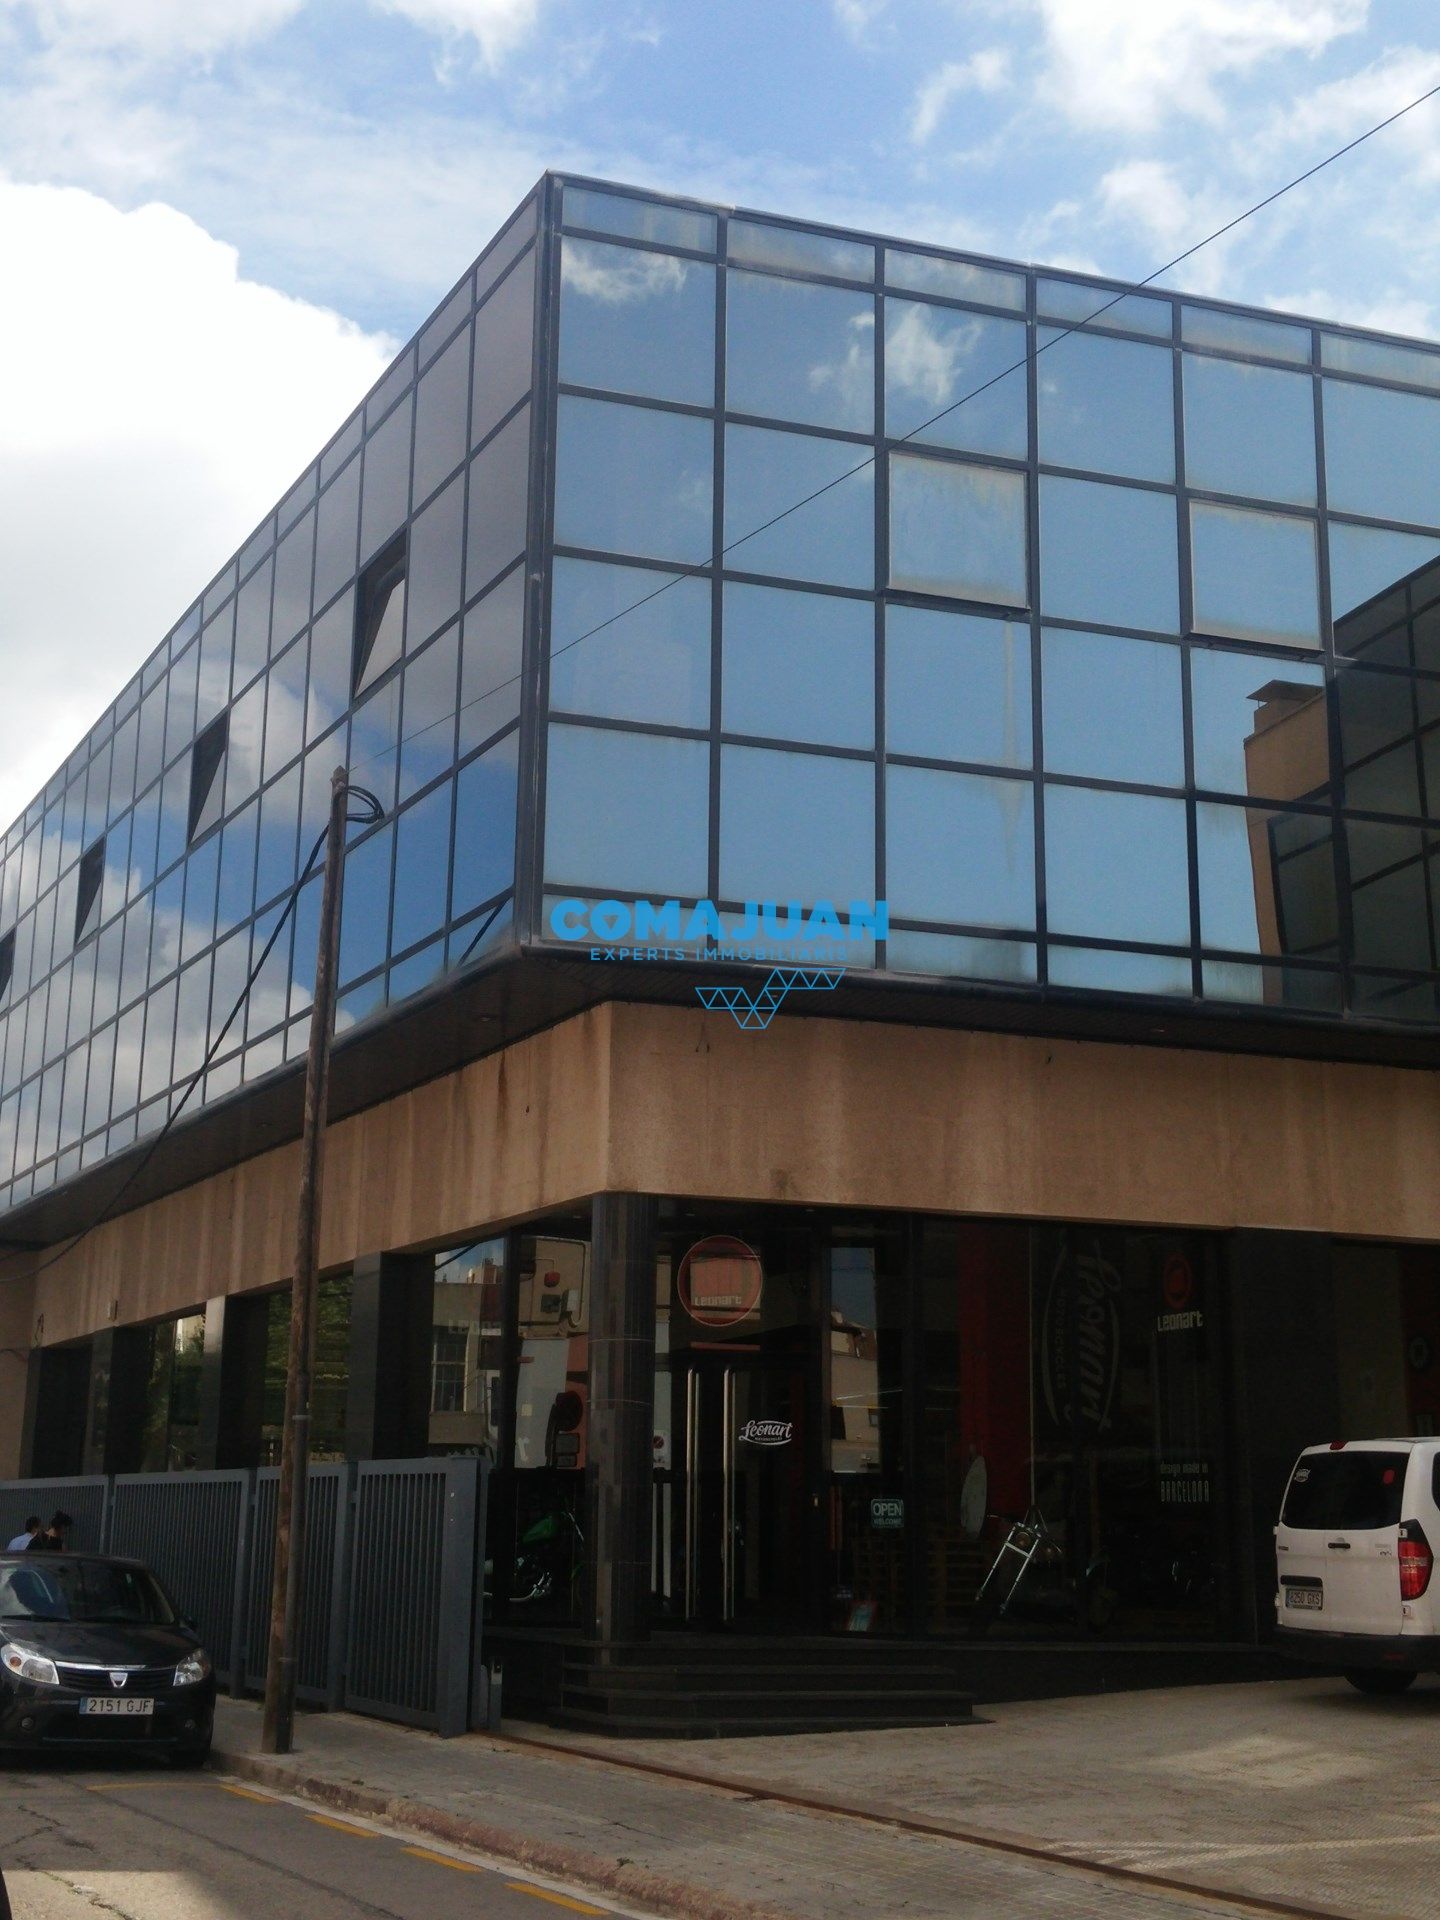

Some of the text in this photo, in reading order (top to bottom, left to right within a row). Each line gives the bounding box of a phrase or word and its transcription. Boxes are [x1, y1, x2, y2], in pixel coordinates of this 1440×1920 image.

[694, 1295, 742, 1307] Leonart
[1156, 1309, 1204, 1332] Leonart
[739, 1420, 793, 1441] Leonart
[873, 1503, 902, 1516] OPEN
[872, 1517, 903, 1526] WELCOME
[89, 1699, 150, 1712] 2151 GJF
